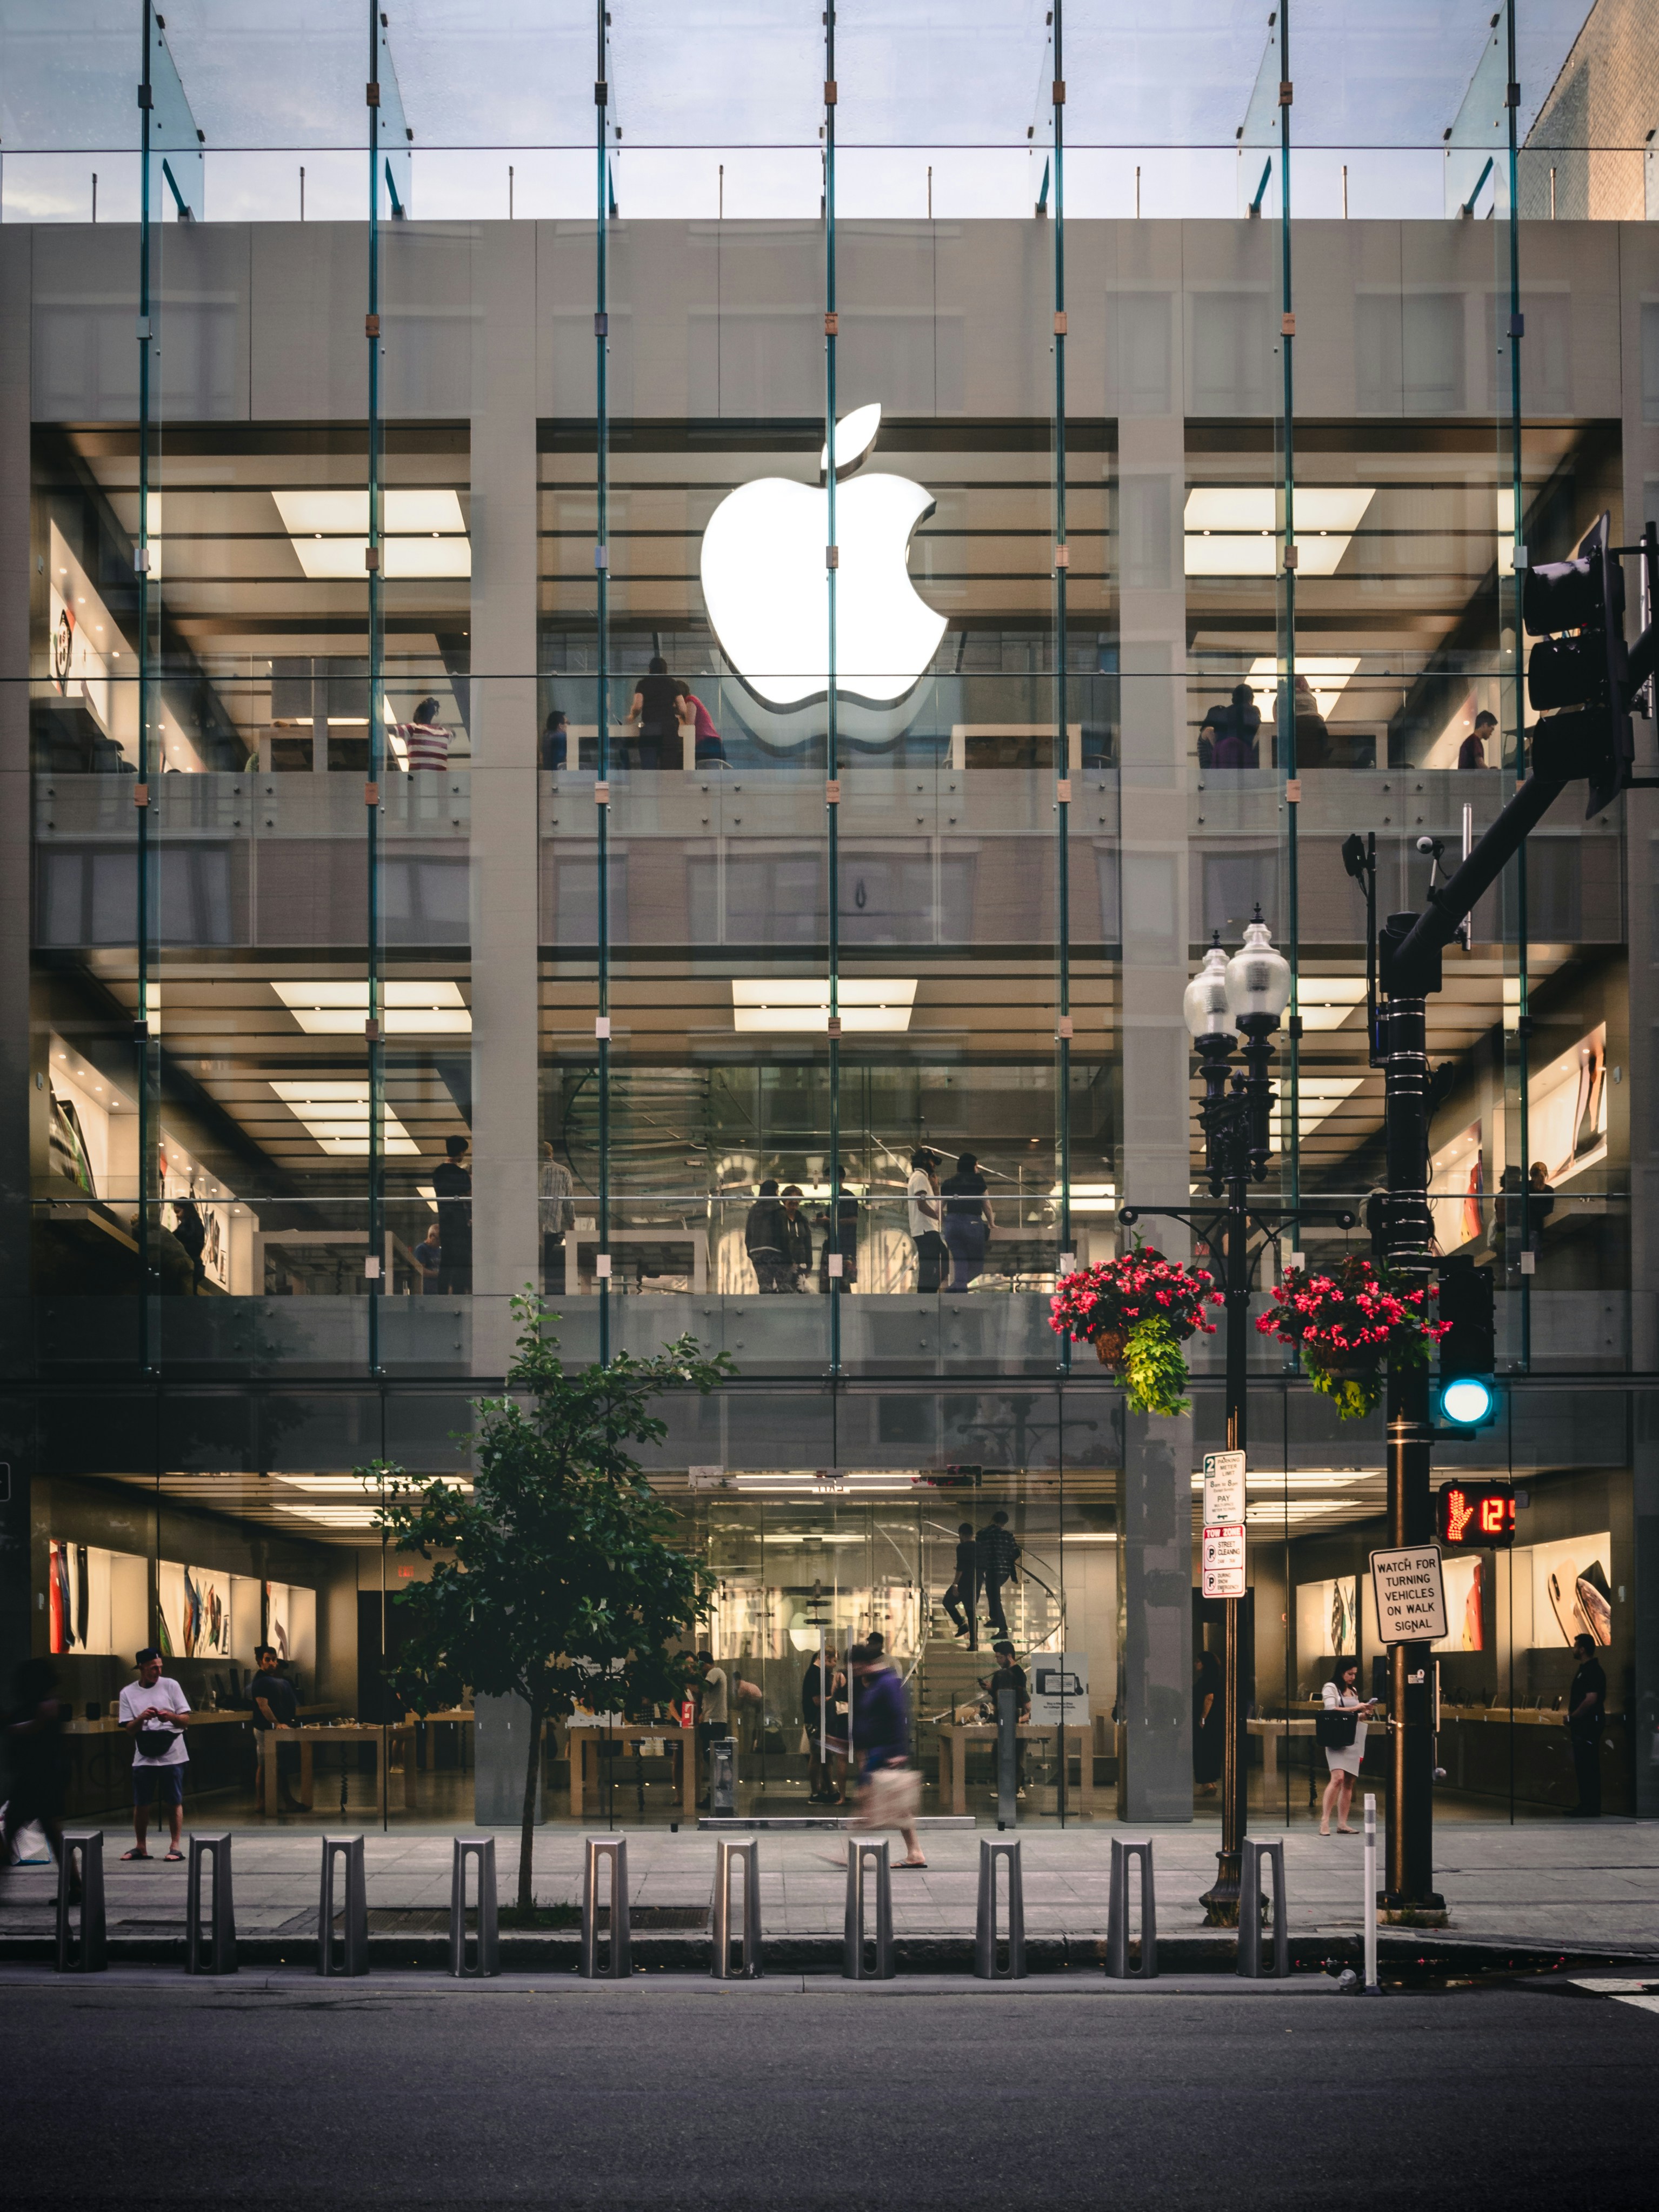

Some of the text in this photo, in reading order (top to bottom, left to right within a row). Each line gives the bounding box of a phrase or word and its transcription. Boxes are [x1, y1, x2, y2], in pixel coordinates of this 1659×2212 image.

[1206, 1458, 1215, 1473] 2
[1206, 1527, 1241, 1538] TOW ZONE
[1377, 1558, 1436, 1574] WATCH FOR
[1386, 1574, 1430, 1587] TURNING
[1385, 1588, 1435, 1601] VEHICLES
[1387, 1602, 1435, 1616] ON WALK
[1395, 1618, 1433, 1631] SIGNAL
